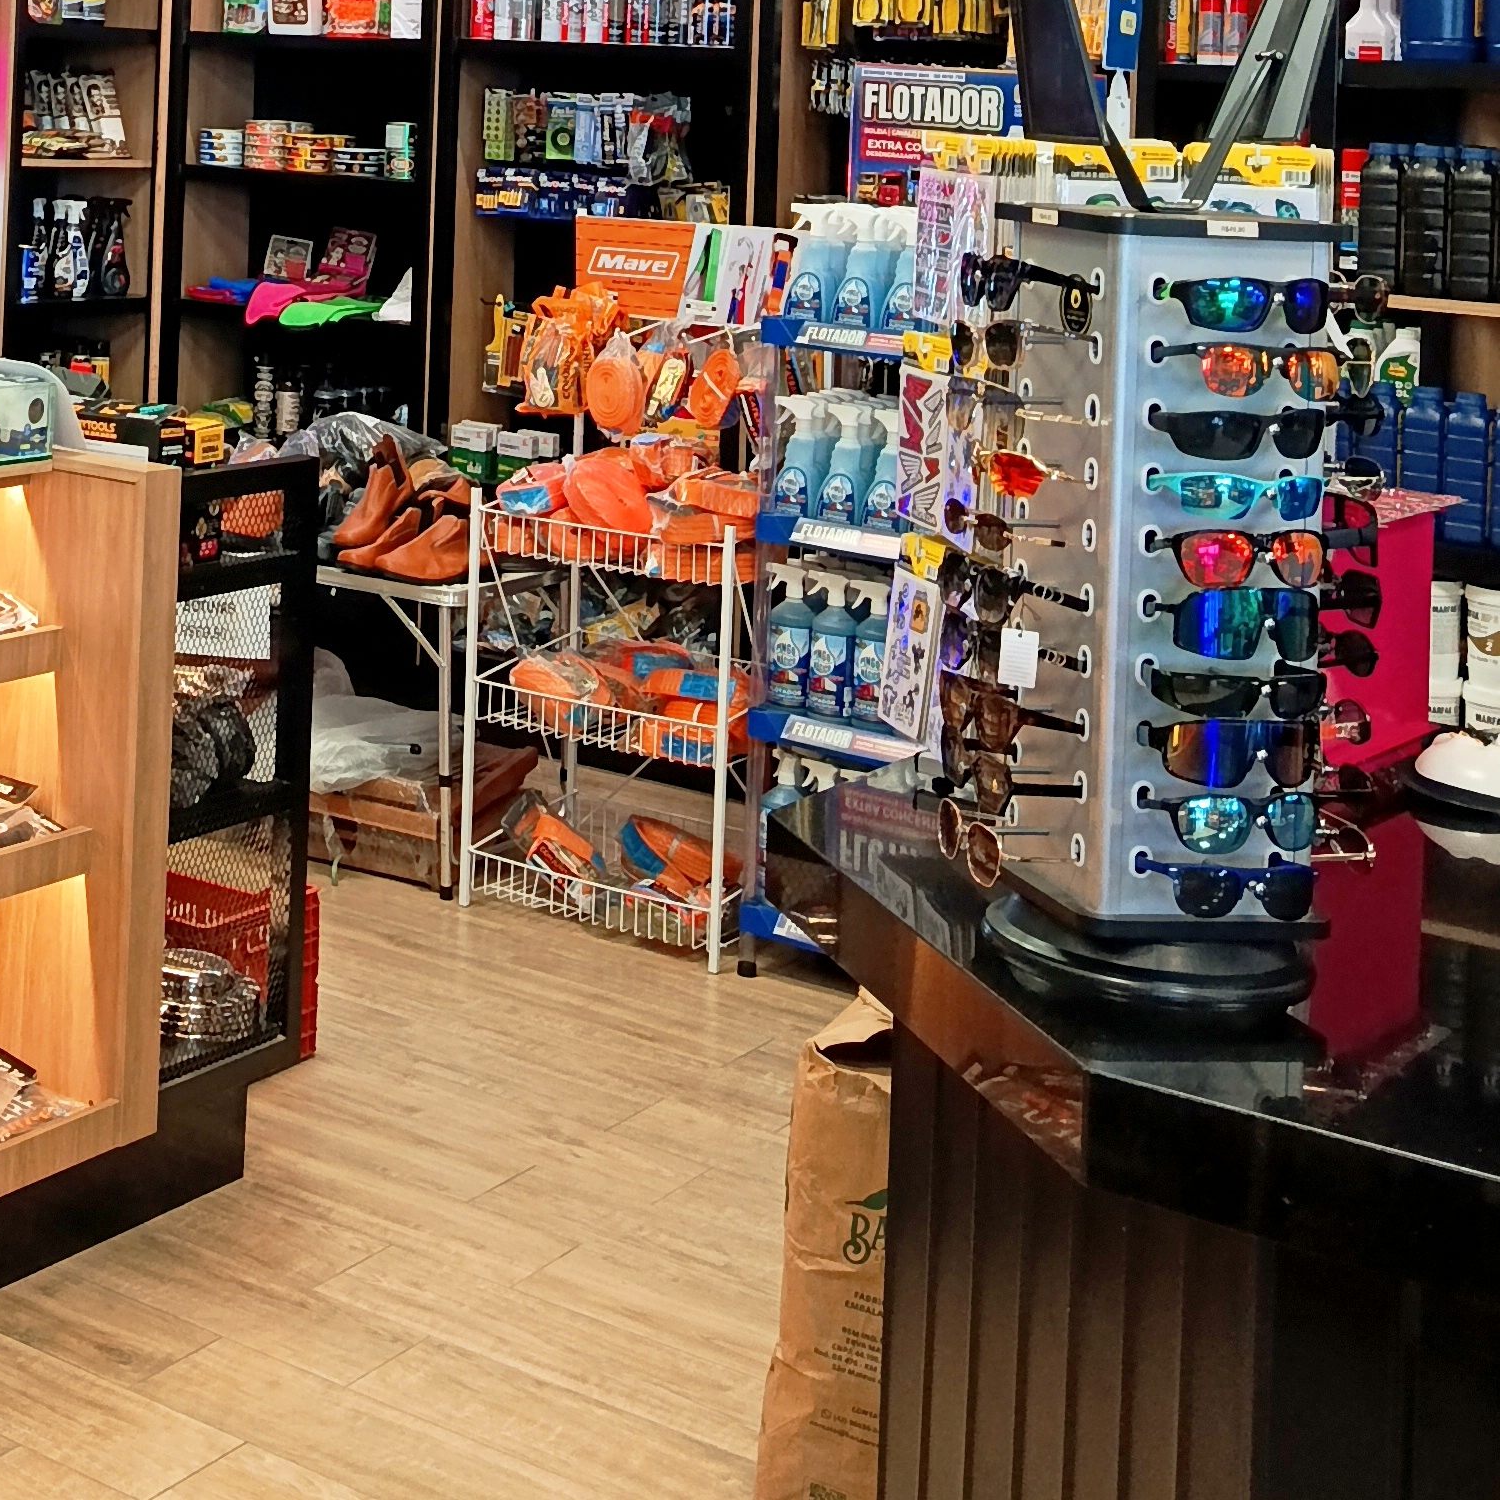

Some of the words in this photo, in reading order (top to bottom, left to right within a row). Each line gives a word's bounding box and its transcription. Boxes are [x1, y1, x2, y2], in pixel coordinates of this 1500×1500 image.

[863, 82, 1001, 127] FLOTADOR
[867, 139, 903, 150] EXTRA
[597, 253, 669, 274] Mave
[805, 326, 867, 347] FLOTADOR
[799, 523, 861, 545] FLOTADOR
[790, 721, 853, 749] FLOTADOR
